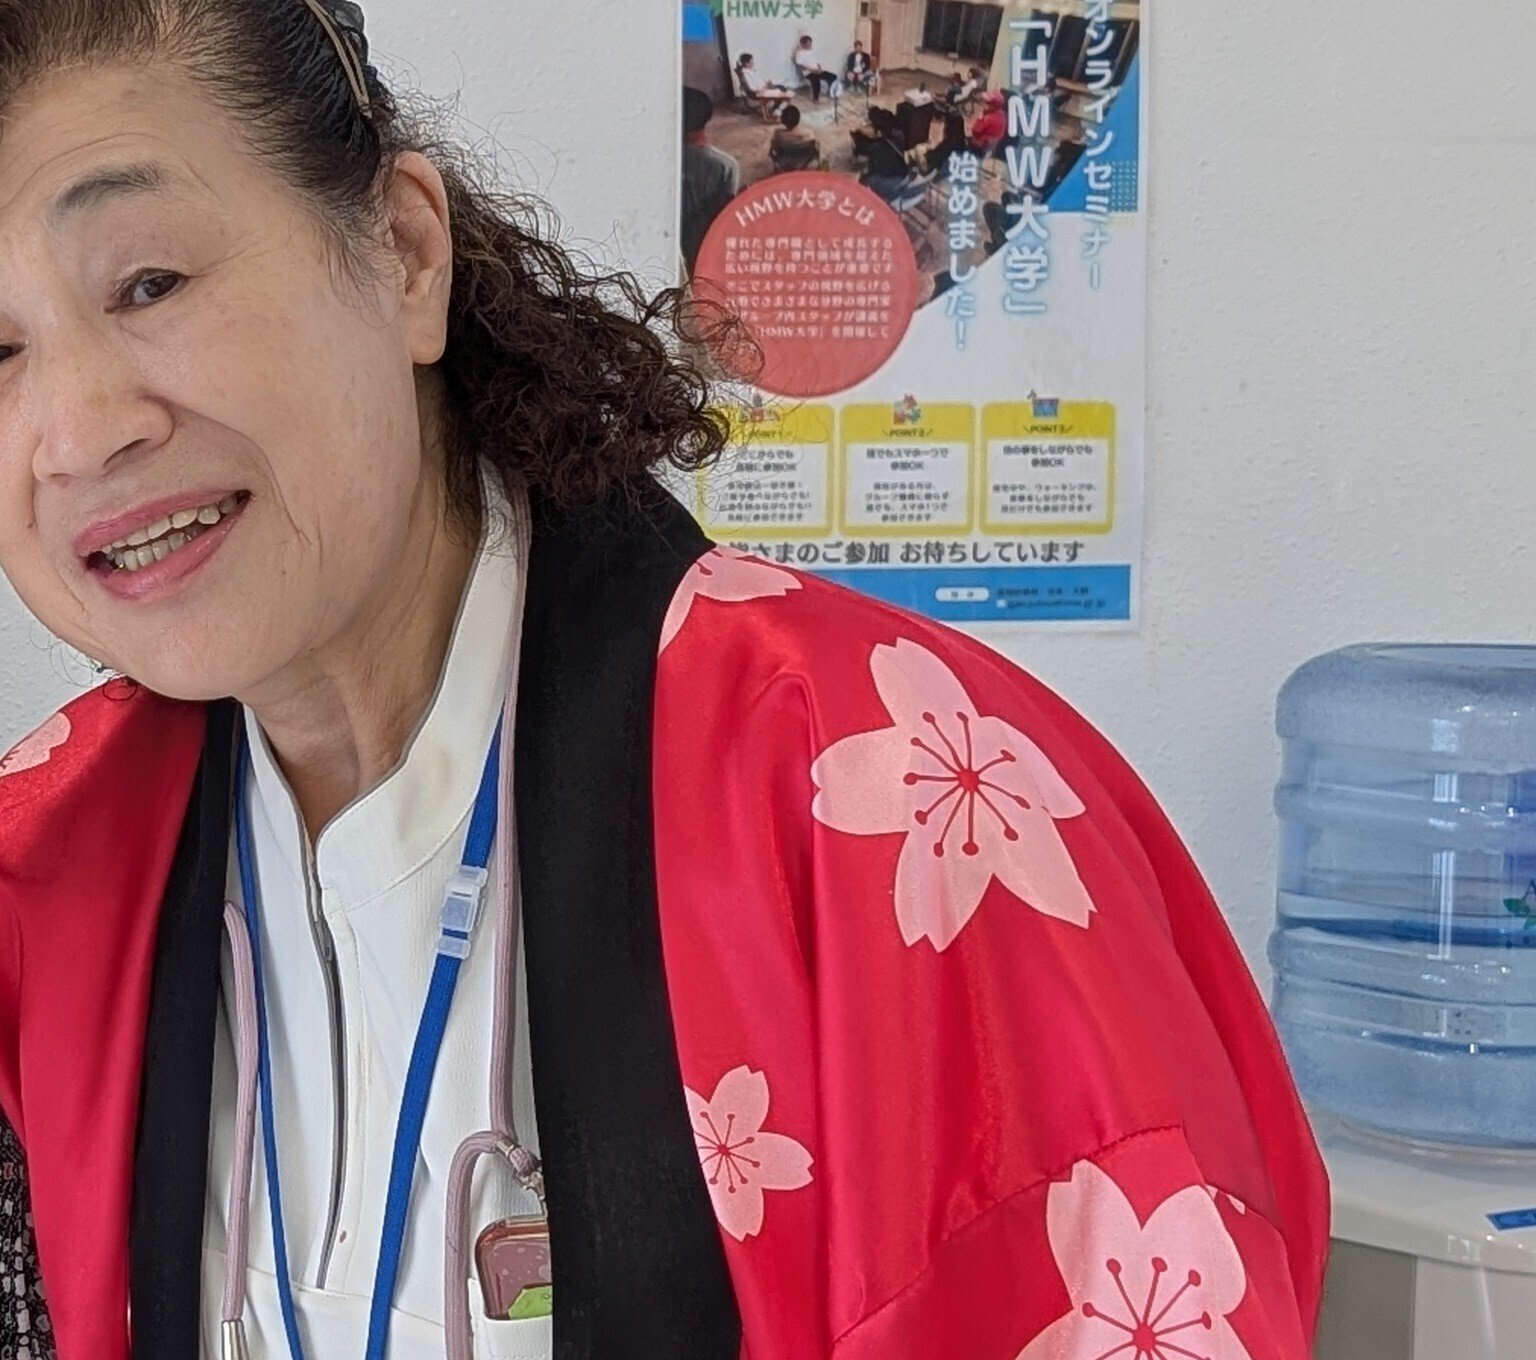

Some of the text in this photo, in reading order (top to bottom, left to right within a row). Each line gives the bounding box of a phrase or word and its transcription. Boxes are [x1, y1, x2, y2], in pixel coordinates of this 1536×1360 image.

[1002, 20, 1053, 314] 「HMW大学」
[734, 188, 876, 228] HMW大学とは
[899, 540, 1085, 564] お待ちしています
